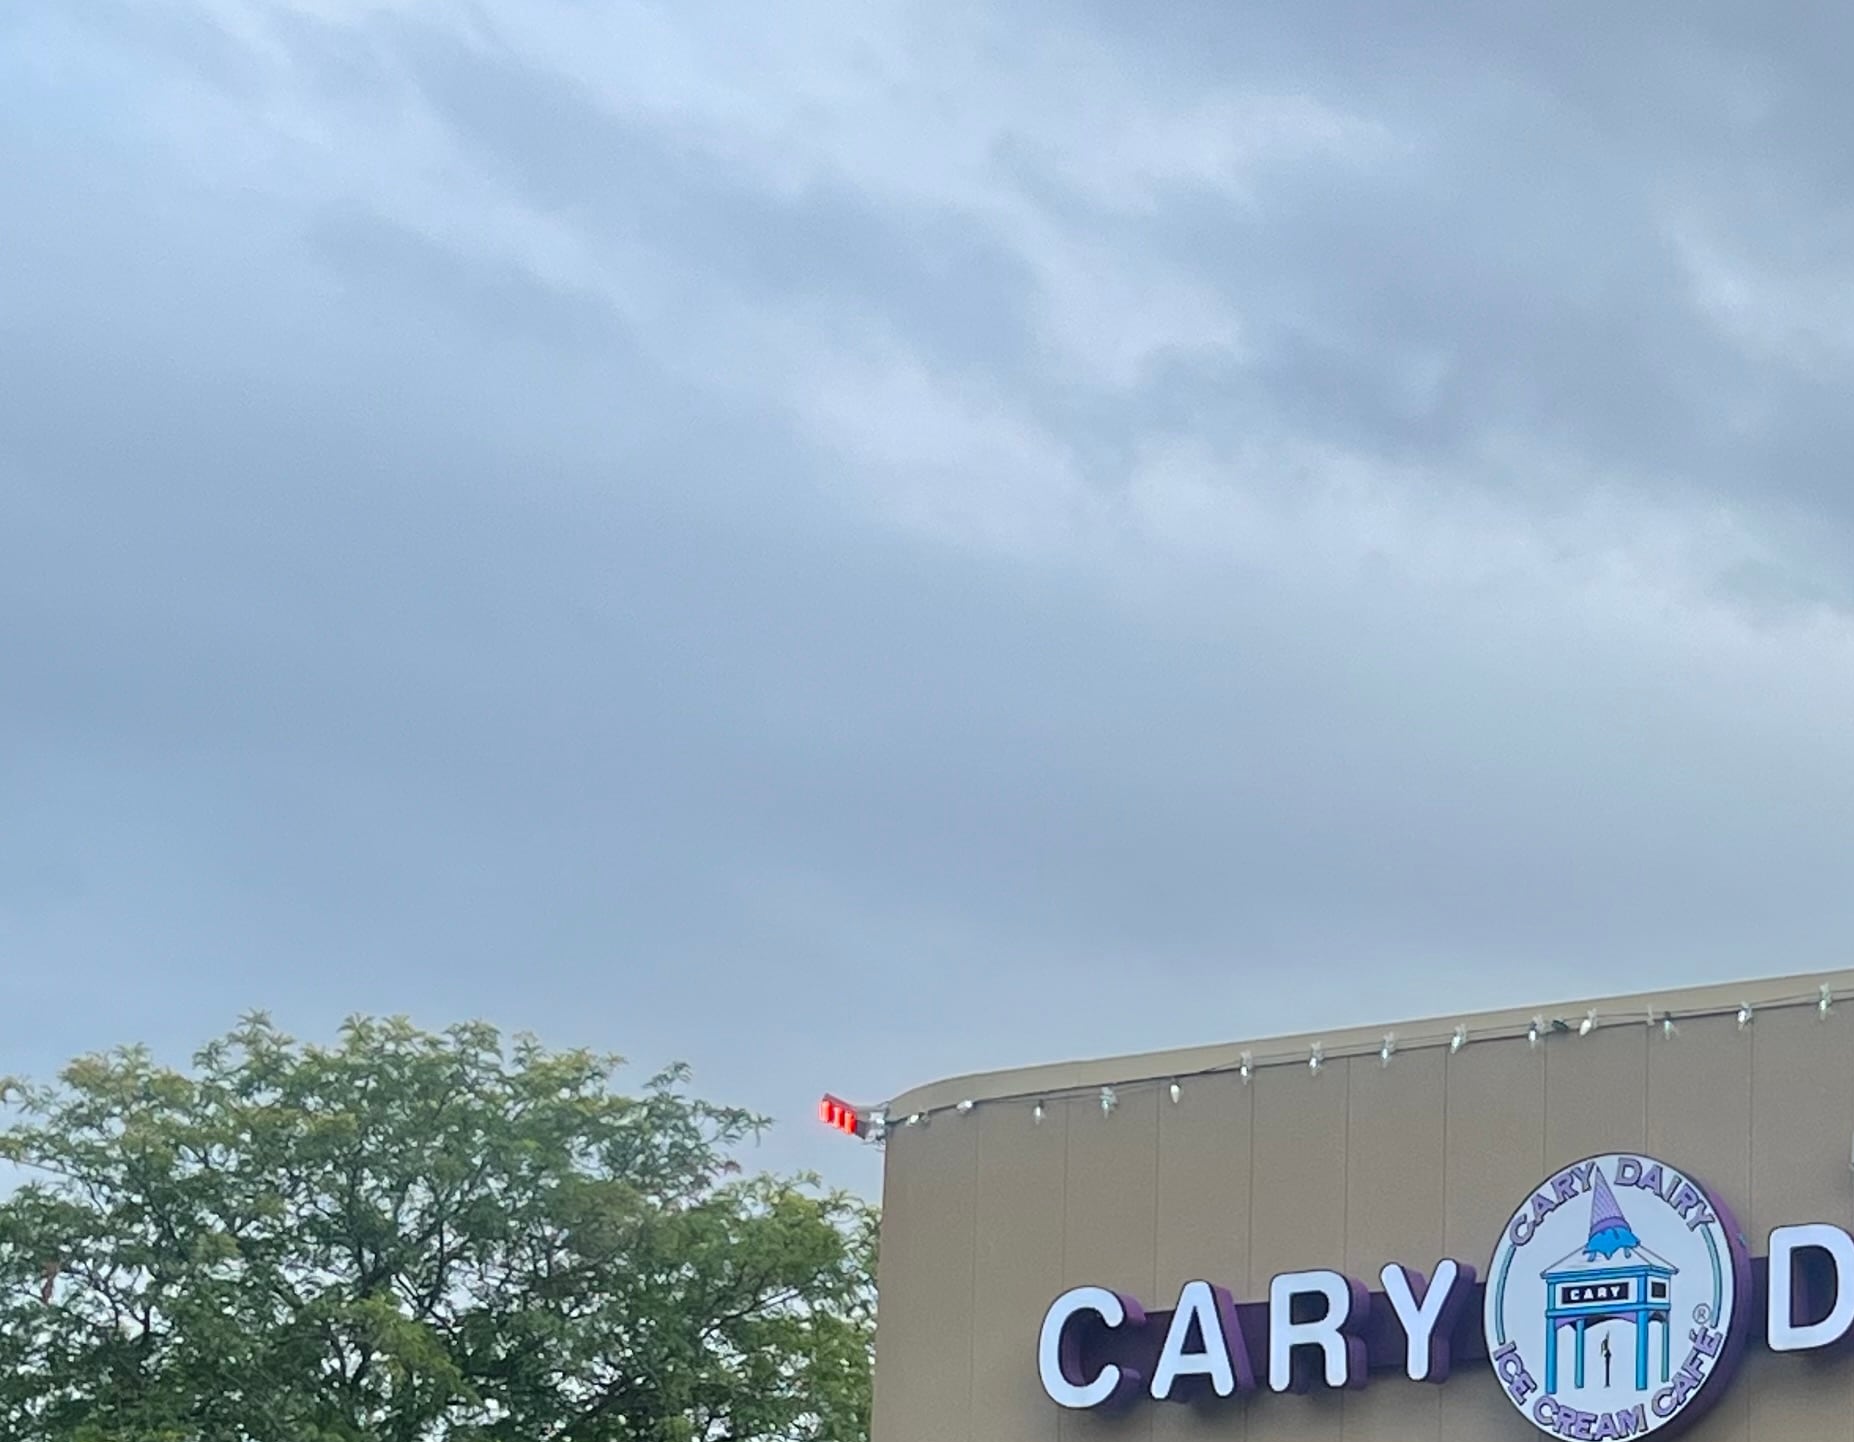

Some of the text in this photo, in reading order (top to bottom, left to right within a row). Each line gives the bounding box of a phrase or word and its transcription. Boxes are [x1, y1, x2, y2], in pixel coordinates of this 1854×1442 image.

[1510, 1157, 1715, 1247] CARY DAIRY
[1038, 1260, 1460, 1408] CARY
[1569, 1286, 1622, 1301] CARY
[1494, 1341, 1538, 1405] ICE
[1533, 1398, 1648, 1442] CREAM
